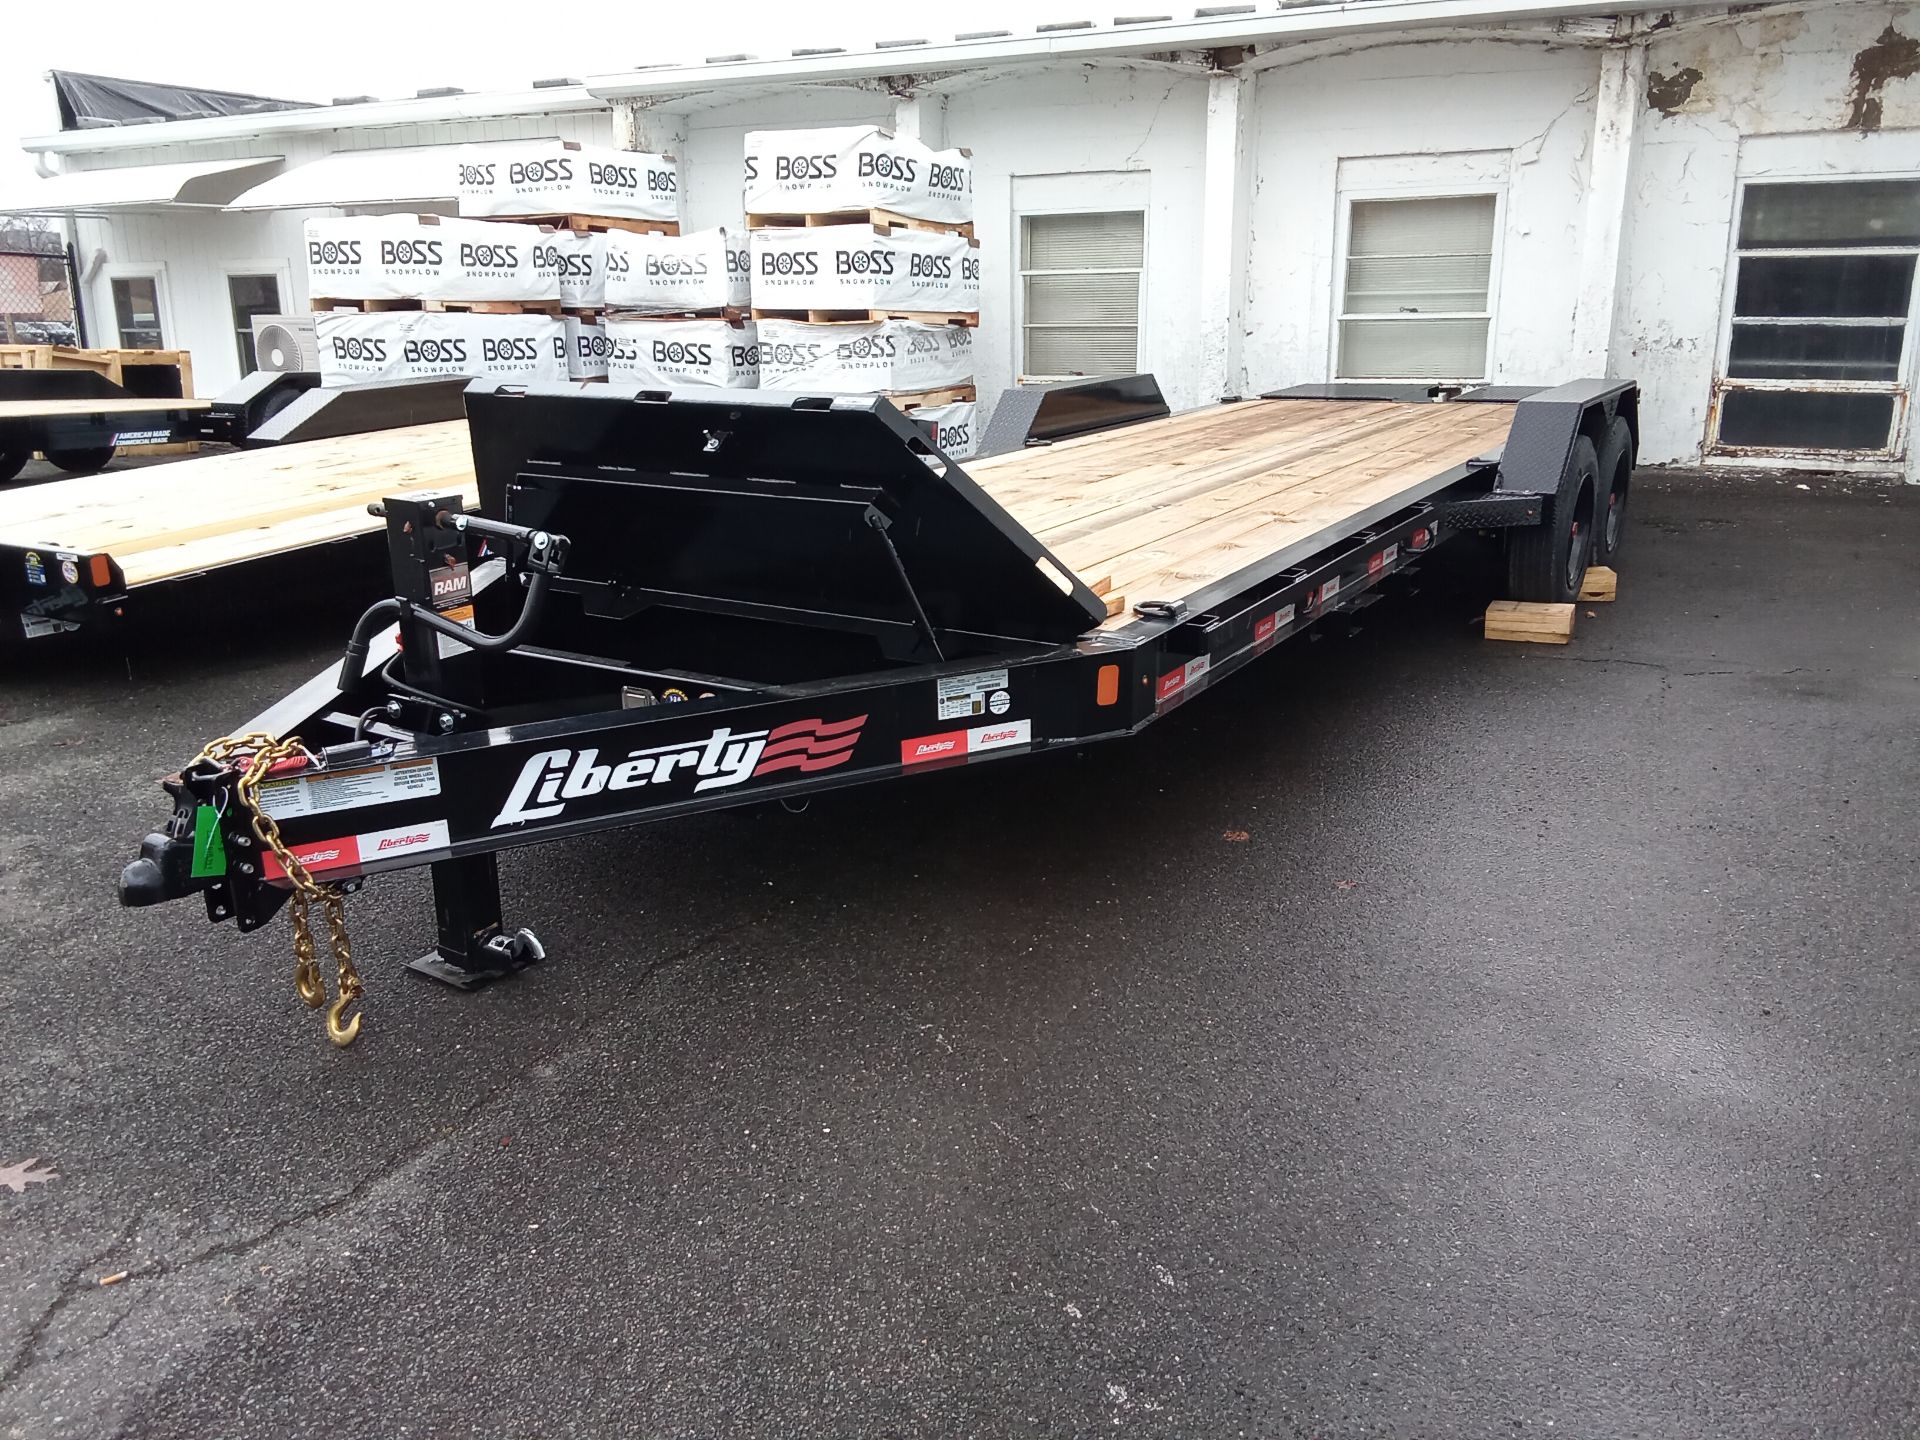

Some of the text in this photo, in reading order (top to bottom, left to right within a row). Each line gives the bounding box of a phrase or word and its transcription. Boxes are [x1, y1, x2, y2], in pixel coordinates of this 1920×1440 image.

[510, 158, 573, 184] BOSS
[589, 162, 637, 188] BOSS
[776, 154, 837, 180] BOSS
[858, 152, 917, 182] BOSS
[928, 163, 964, 191] BOSS
[593, 188, 635, 197] SNOWPOW
[309, 241, 361, 264] BOSS
[381, 240, 442, 265] BOSS
[460, 243, 518, 268] BOSS
[606, 248, 629, 272] SS
[646, 253, 707, 275] BOSS
[762, 252, 818, 275] BOSS
[836, 250, 895, 275] BOSS
[385, 268, 439, 276] SNOWPLOW
[910, 253, 951, 278] BOSS
[333, 337, 387, 361] BOSS
[404, 339, 467, 362] BOSS
[482, 338, 537, 361] BOSS
[653, 340, 711, 365] BOSS
[758, 342, 821, 366] BOSS
[837, 334, 896, 360] BOSS
[116, 438, 150, 446] COMMERCIAL
[119, 431, 152, 439] AMERICAN
[939, 423, 969, 449] BOSS
[434, 576, 467, 596] RAM
[981, 732, 1006, 743] Liberty
[490, 728, 769, 829] Liberty
[377, 836, 415, 851] Liberty
